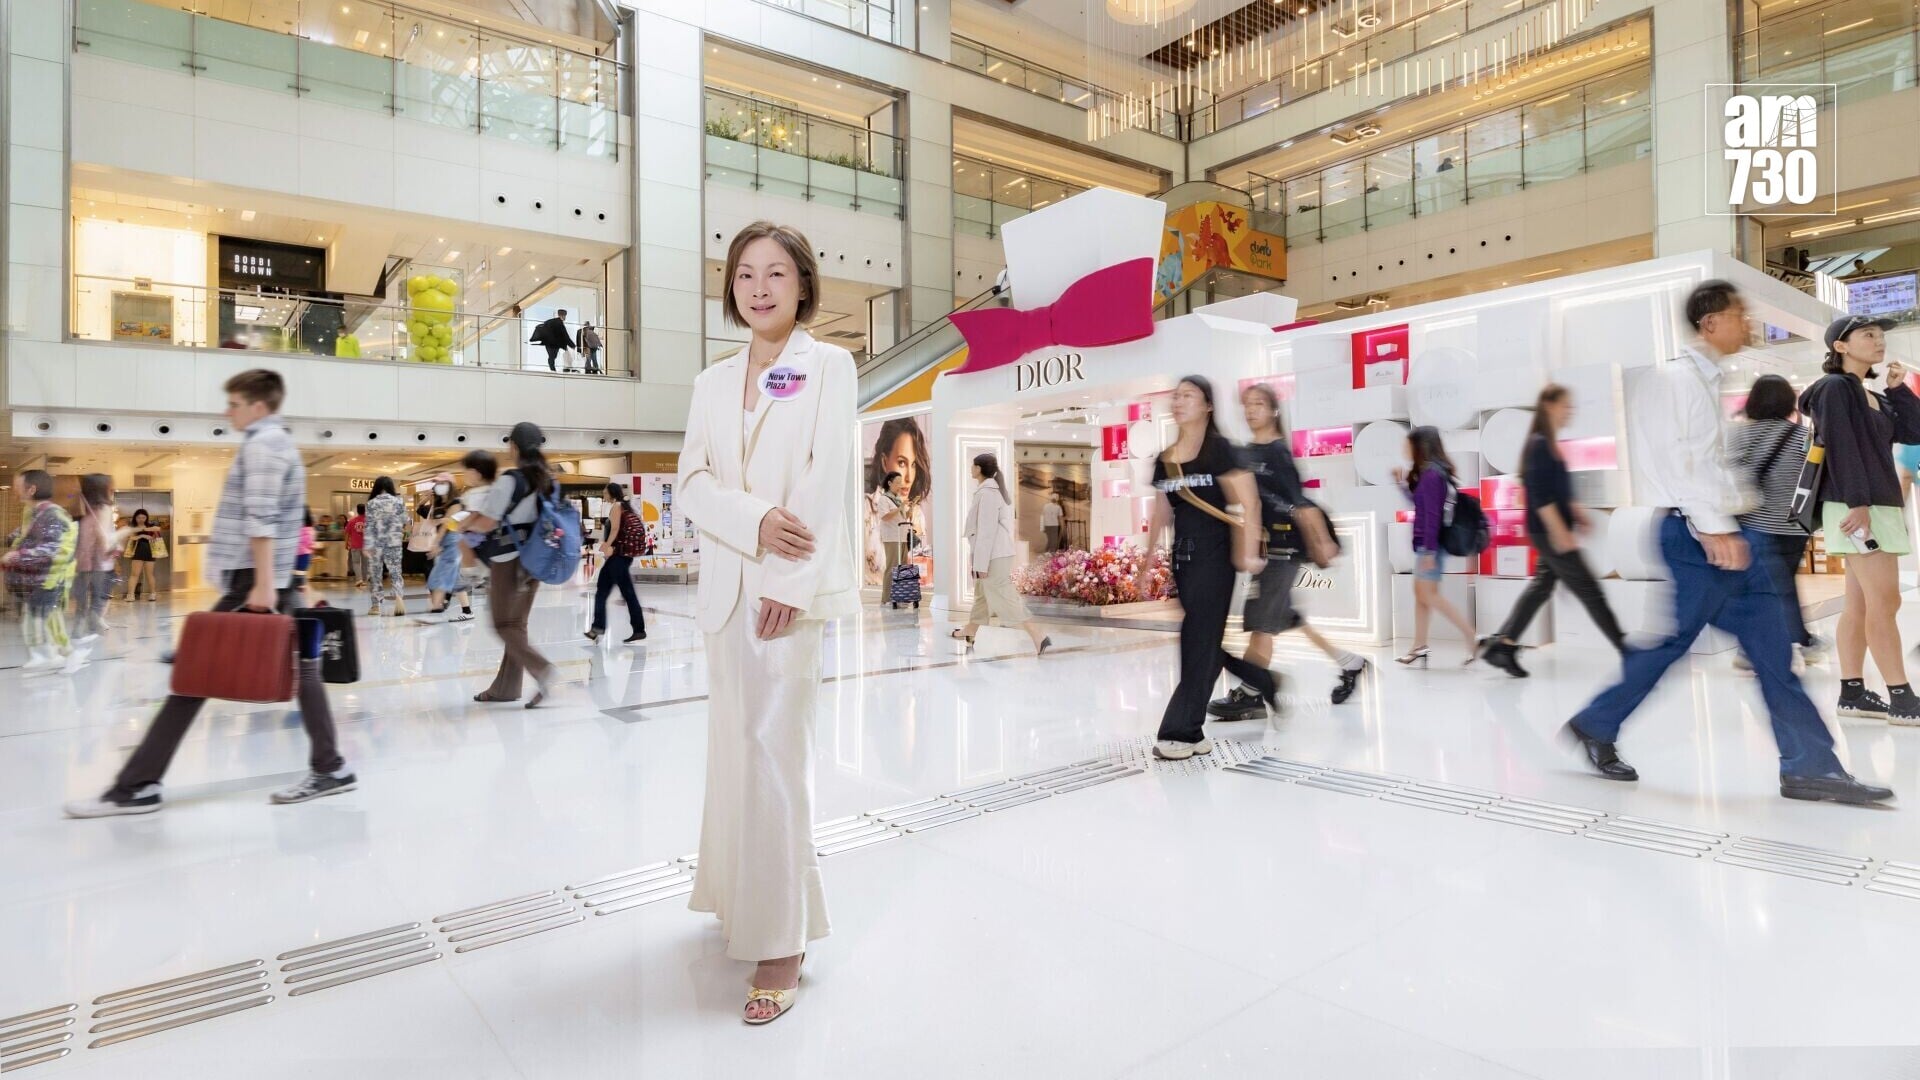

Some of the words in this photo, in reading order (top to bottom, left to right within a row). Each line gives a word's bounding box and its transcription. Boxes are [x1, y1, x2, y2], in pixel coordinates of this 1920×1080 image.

[234, 254, 271, 267] BOBBI
[234, 264, 272, 276] BROWN
[767, 372, 786, 381] New
[786, 373, 807, 381] Town
[1015, 353, 1085, 392] DIOR
[765, 381, 787, 390] Plaza
[351, 478, 375, 490] SAND
[1292, 566, 1334, 589] Dior
